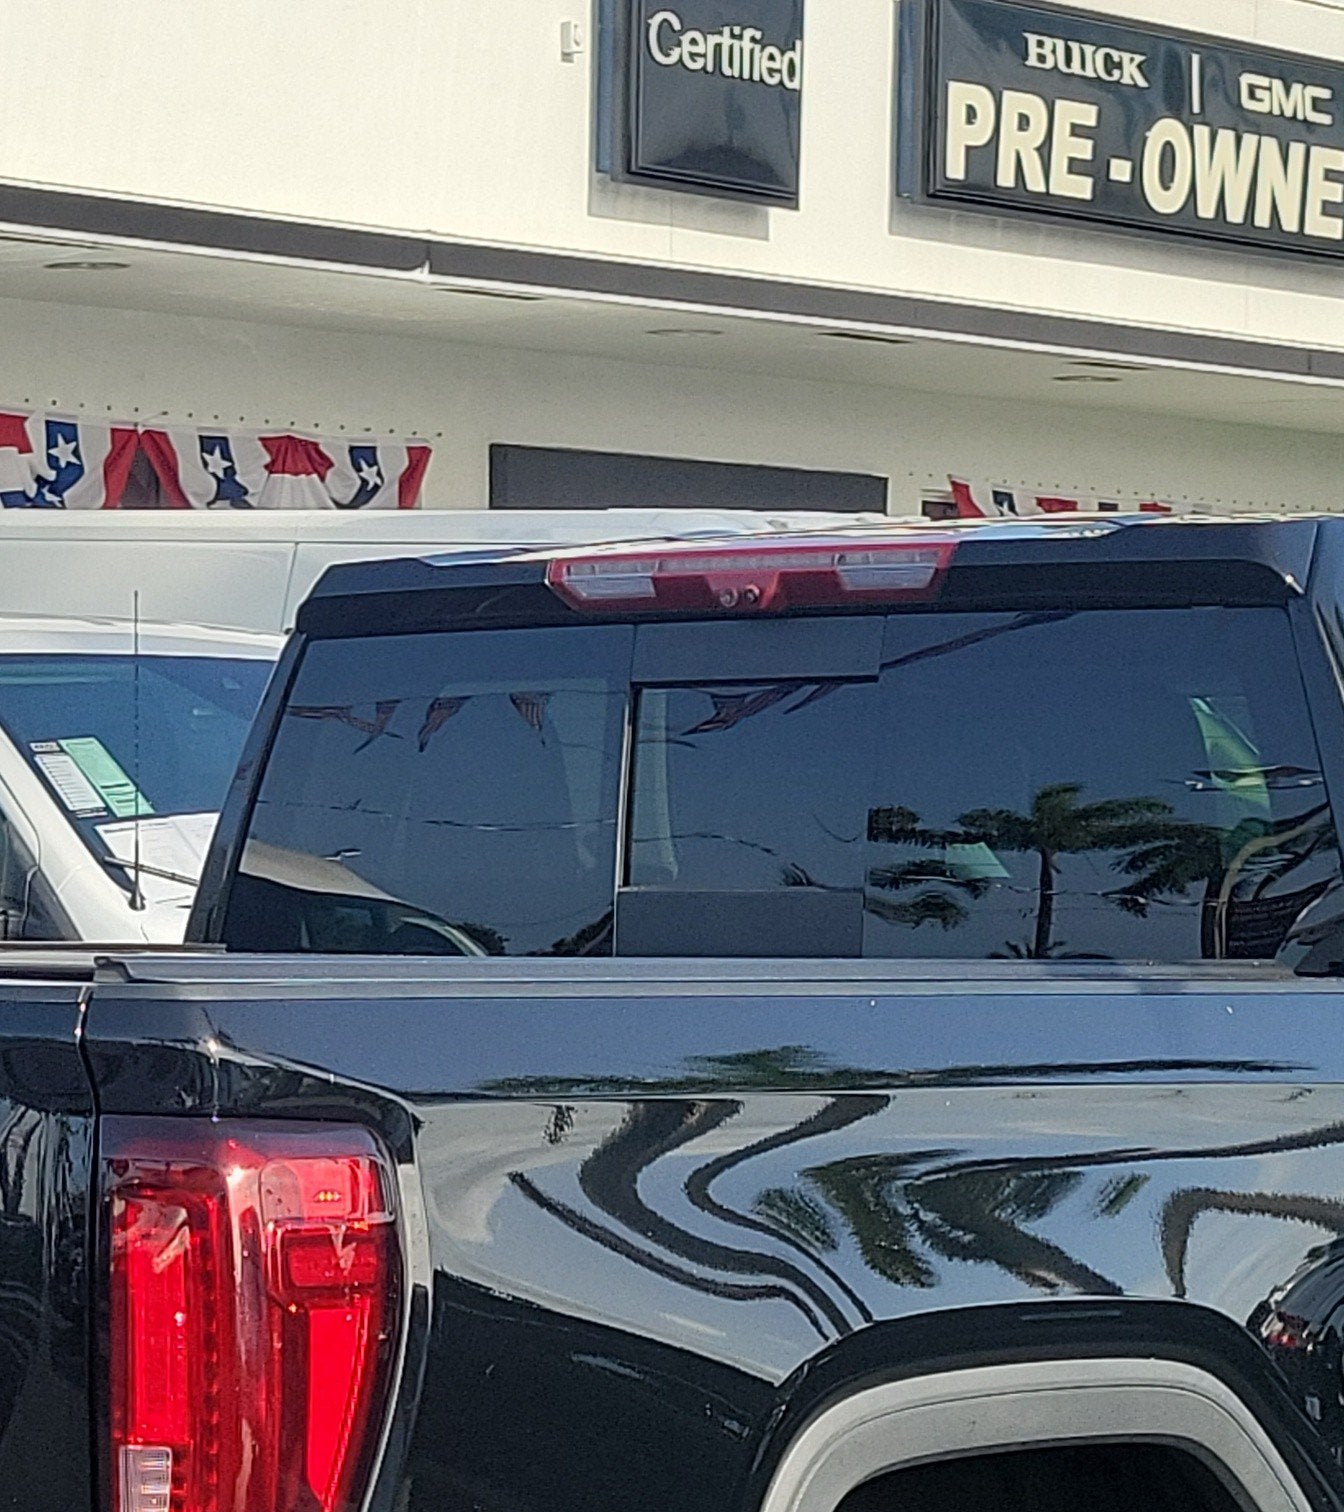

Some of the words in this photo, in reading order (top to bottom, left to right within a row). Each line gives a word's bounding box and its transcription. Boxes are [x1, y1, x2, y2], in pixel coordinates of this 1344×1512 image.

[647, 10, 802, 91] Certified
[1022, 32, 1149, 88] BUICK
[1239, 73, 1333, 125] GMC
